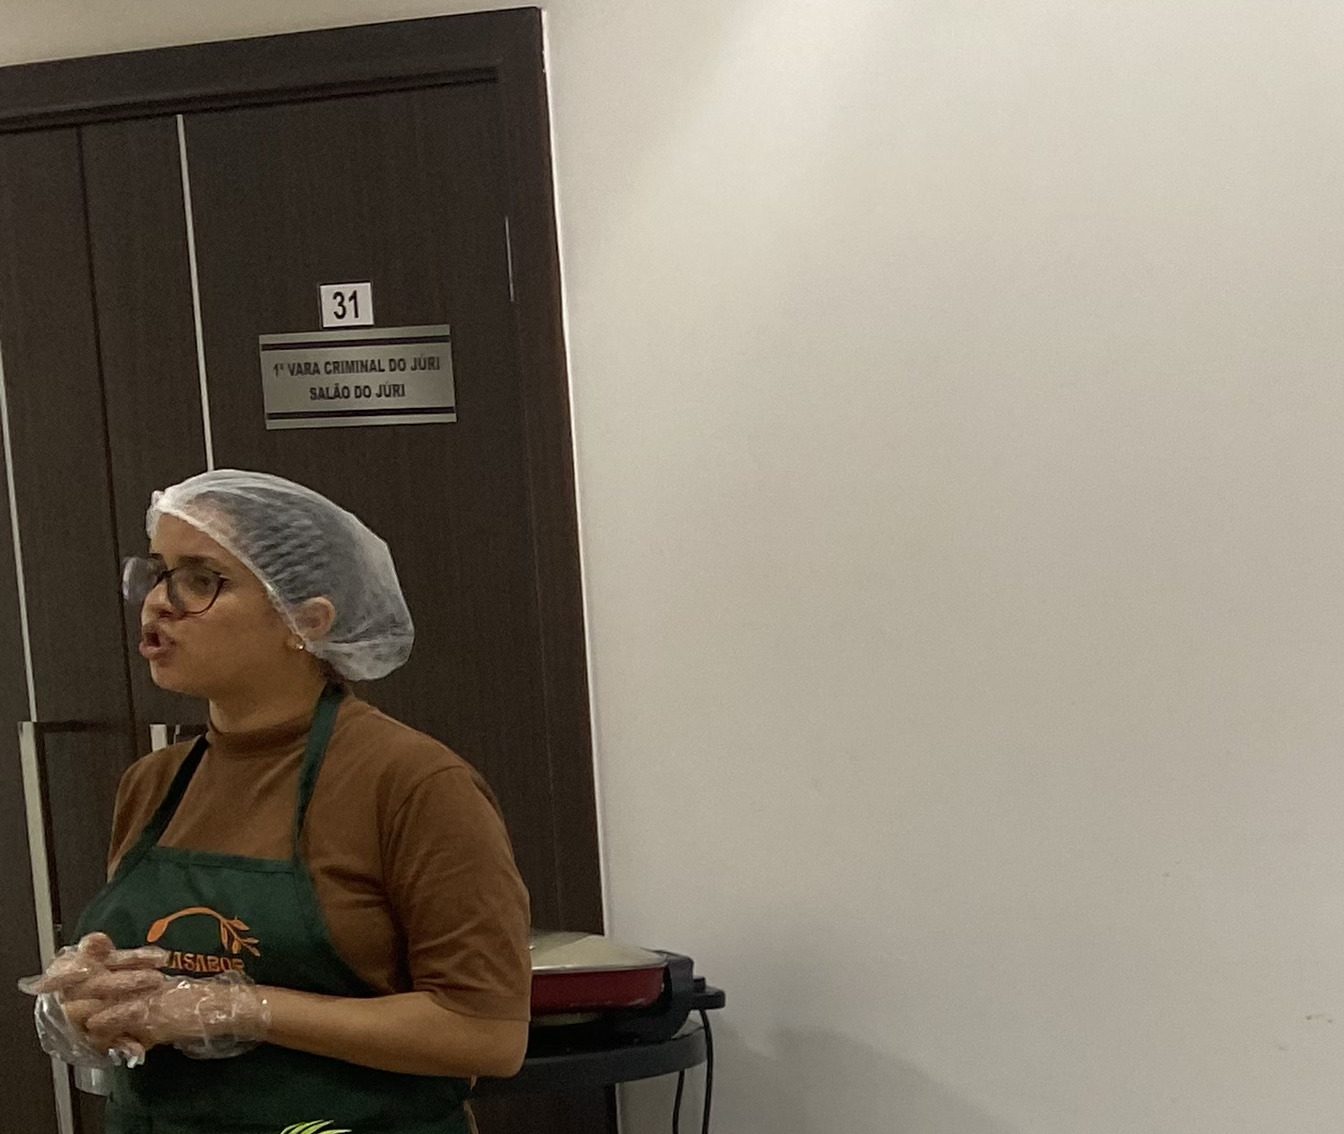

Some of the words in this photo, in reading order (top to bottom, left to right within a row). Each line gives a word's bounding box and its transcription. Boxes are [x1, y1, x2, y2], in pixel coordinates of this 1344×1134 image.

[333, 290, 359, 319] 31
[288, 362, 321, 376] VARA
[324, 359, 385, 375] CRIMINAL
[389, 358, 406, 372] DO
[410, 354, 440, 371] JÚRI
[309, 383, 350, 400] SALÃO
[354, 385, 372, 399] DO
[375, 381, 406, 398] JÚRI
[168, 951, 245, 973] ASABOR
